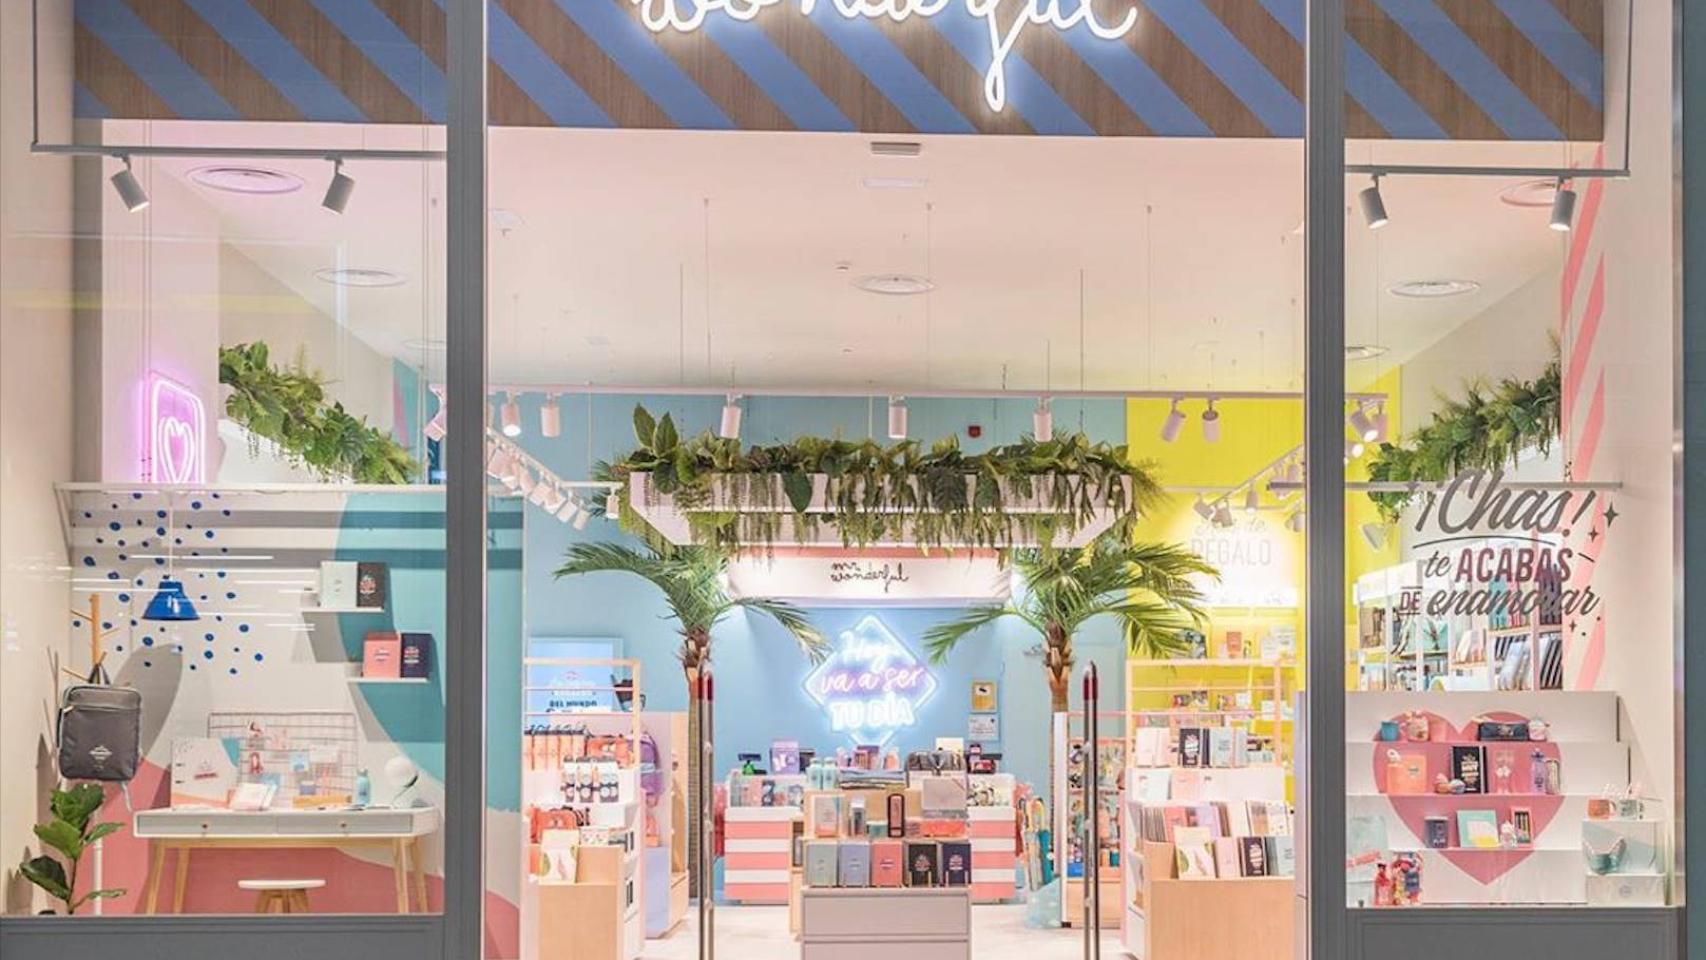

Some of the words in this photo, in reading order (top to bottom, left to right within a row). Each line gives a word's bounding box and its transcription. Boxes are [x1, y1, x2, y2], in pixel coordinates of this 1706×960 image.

[1425, 550, 1452, 578] te
[1455, 547, 1574, 583] ACABAS
[1400, 590, 1421, 611] DE
[1426, 585, 1601, 616] enamorar
[821, 673, 855, 693] va
[829, 701, 865, 731] TU
